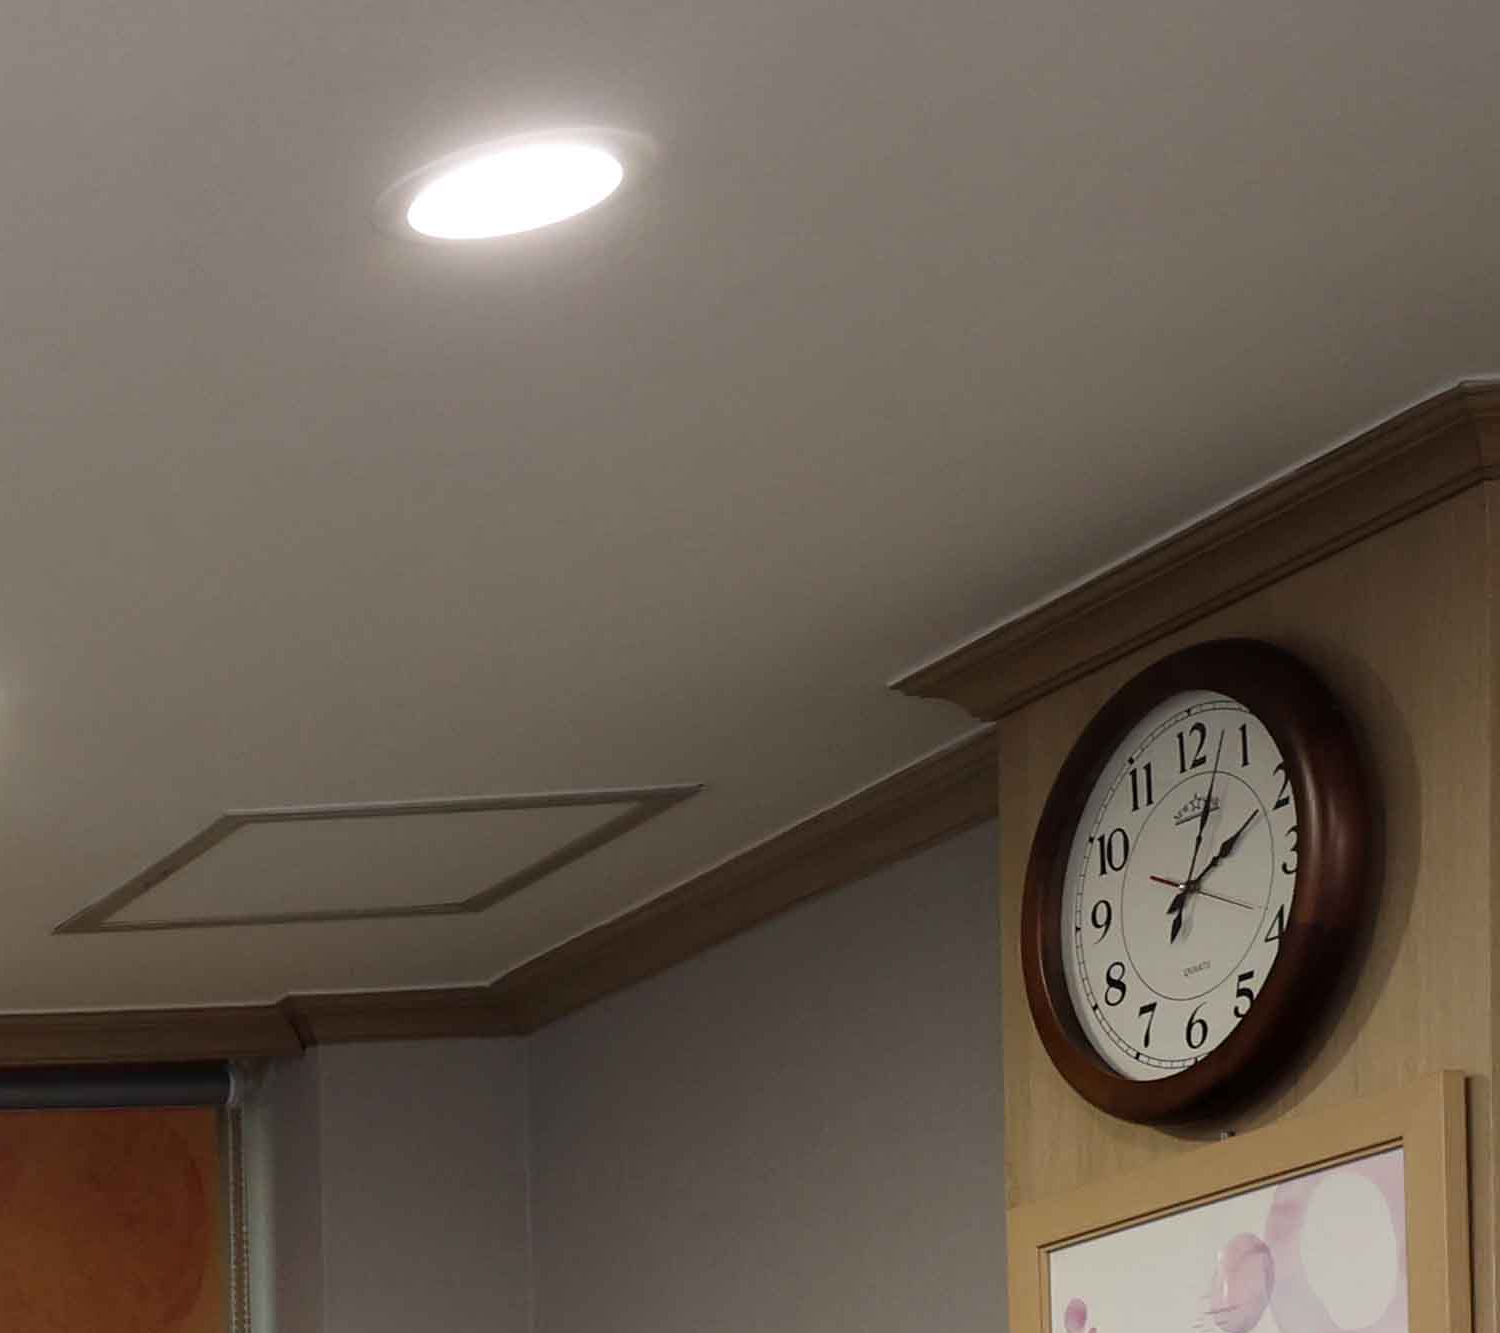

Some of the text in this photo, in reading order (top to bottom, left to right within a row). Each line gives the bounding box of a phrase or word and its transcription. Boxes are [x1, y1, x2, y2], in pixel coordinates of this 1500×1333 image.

[1177, 721, 1208, 774] 12
[1237, 723, 1250, 768] 1
[1128, 761, 1155, 812] 11
[1272, 762, 1291, 810] 2
[1097, 827, 1130, 877] 10
[1282, 825, 1299, 875] 3
[1090, 899, 1112, 945] 9
[1264, 904, 1286, 945] 4
[1103, 961, 1128, 1007] 8
[1233, 970, 1257, 1019] 5
[1137, 1001, 1158, 1049] 7
[1184, 1000, 1209, 1050] 6
